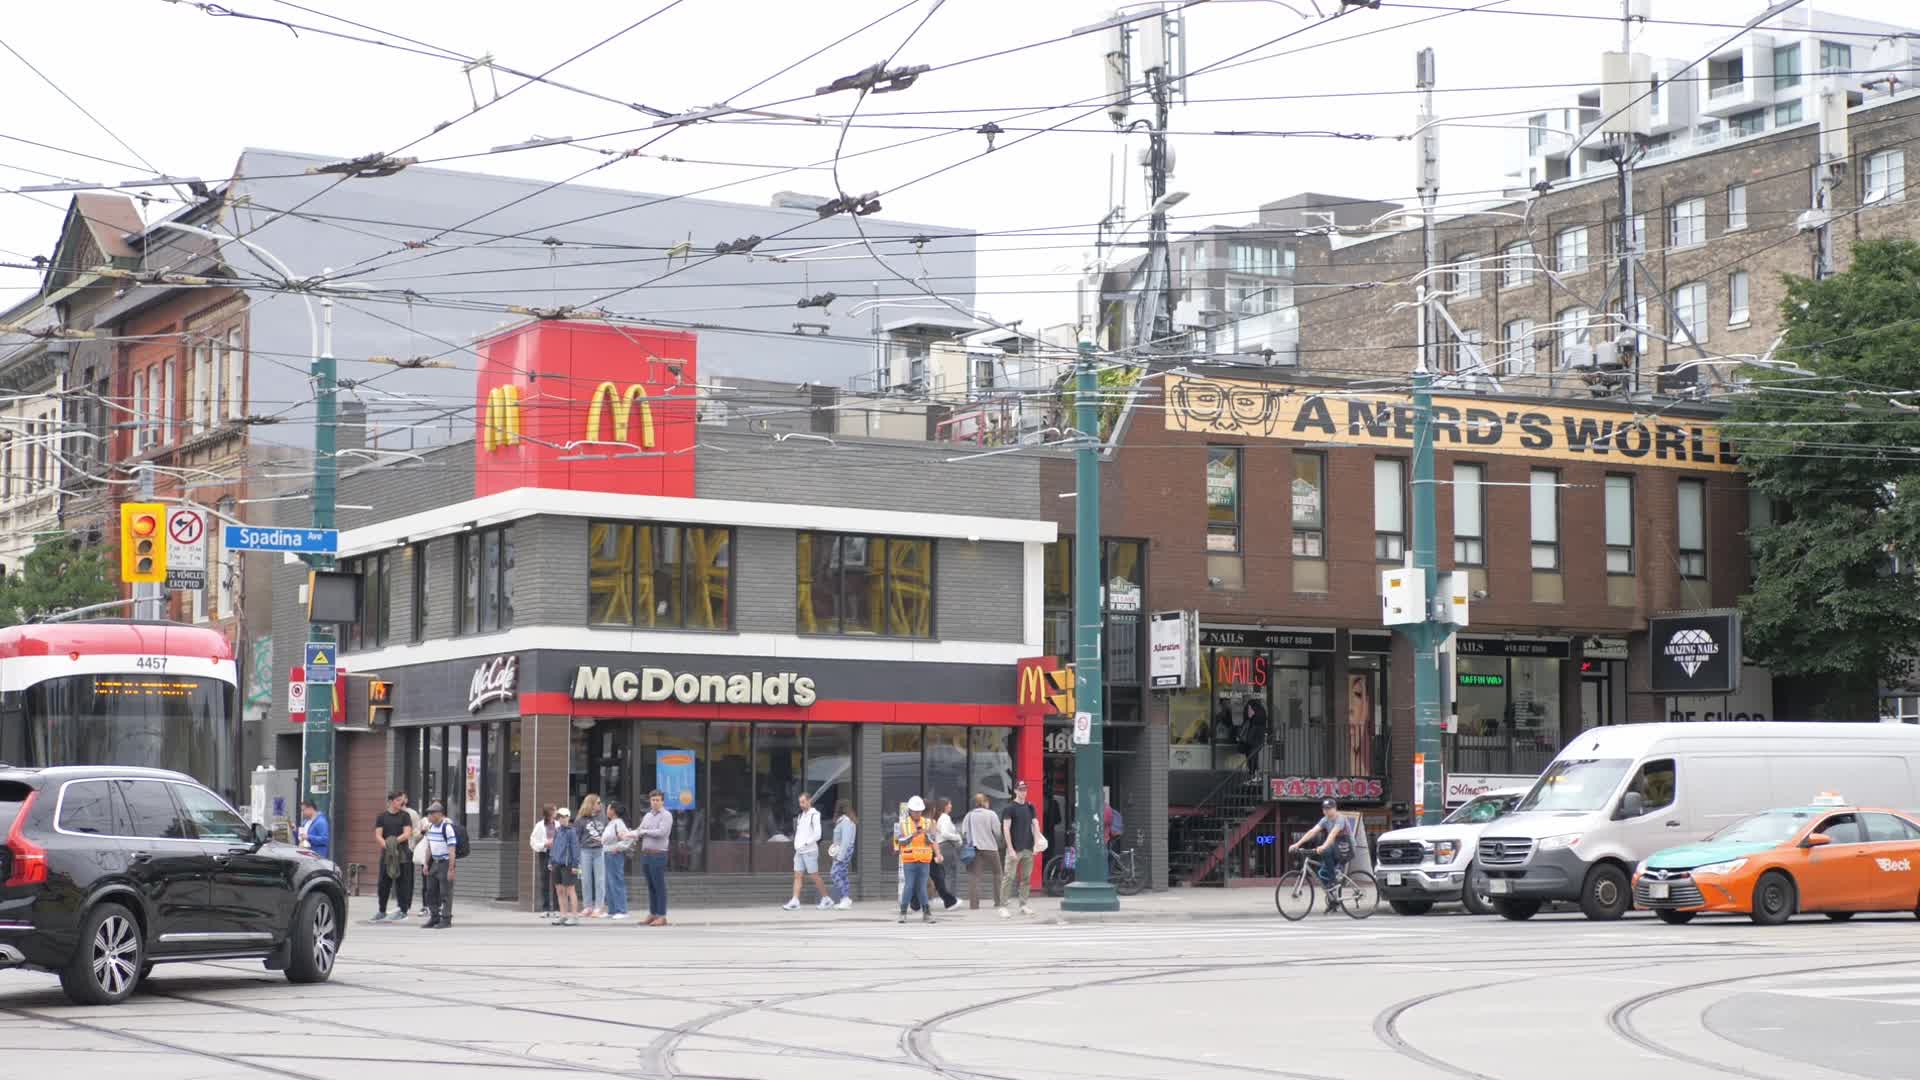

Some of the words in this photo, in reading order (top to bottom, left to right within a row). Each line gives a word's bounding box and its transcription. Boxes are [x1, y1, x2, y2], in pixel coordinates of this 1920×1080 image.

[1292, 395, 1336, 434] A
[1349, 401, 1553, 451] NERD'S
[240, 528, 302, 552] Spadina
[307, 532, 322, 540] Ave
[1210, 632, 1244, 644] NAILS
[1457, 640, 1484, 651] NAILS
[1664, 645, 1696, 655] AMAZING
[1697, 644, 1719, 654] NAILS
[136, 657, 168, 669] 4457
[1218, 655, 1267, 687] NAILS
[573, 666, 817, 706] McDonald's
[1271, 778, 1384, 798] TATTOOS
[1875, 858, 1911, 872] Beck
